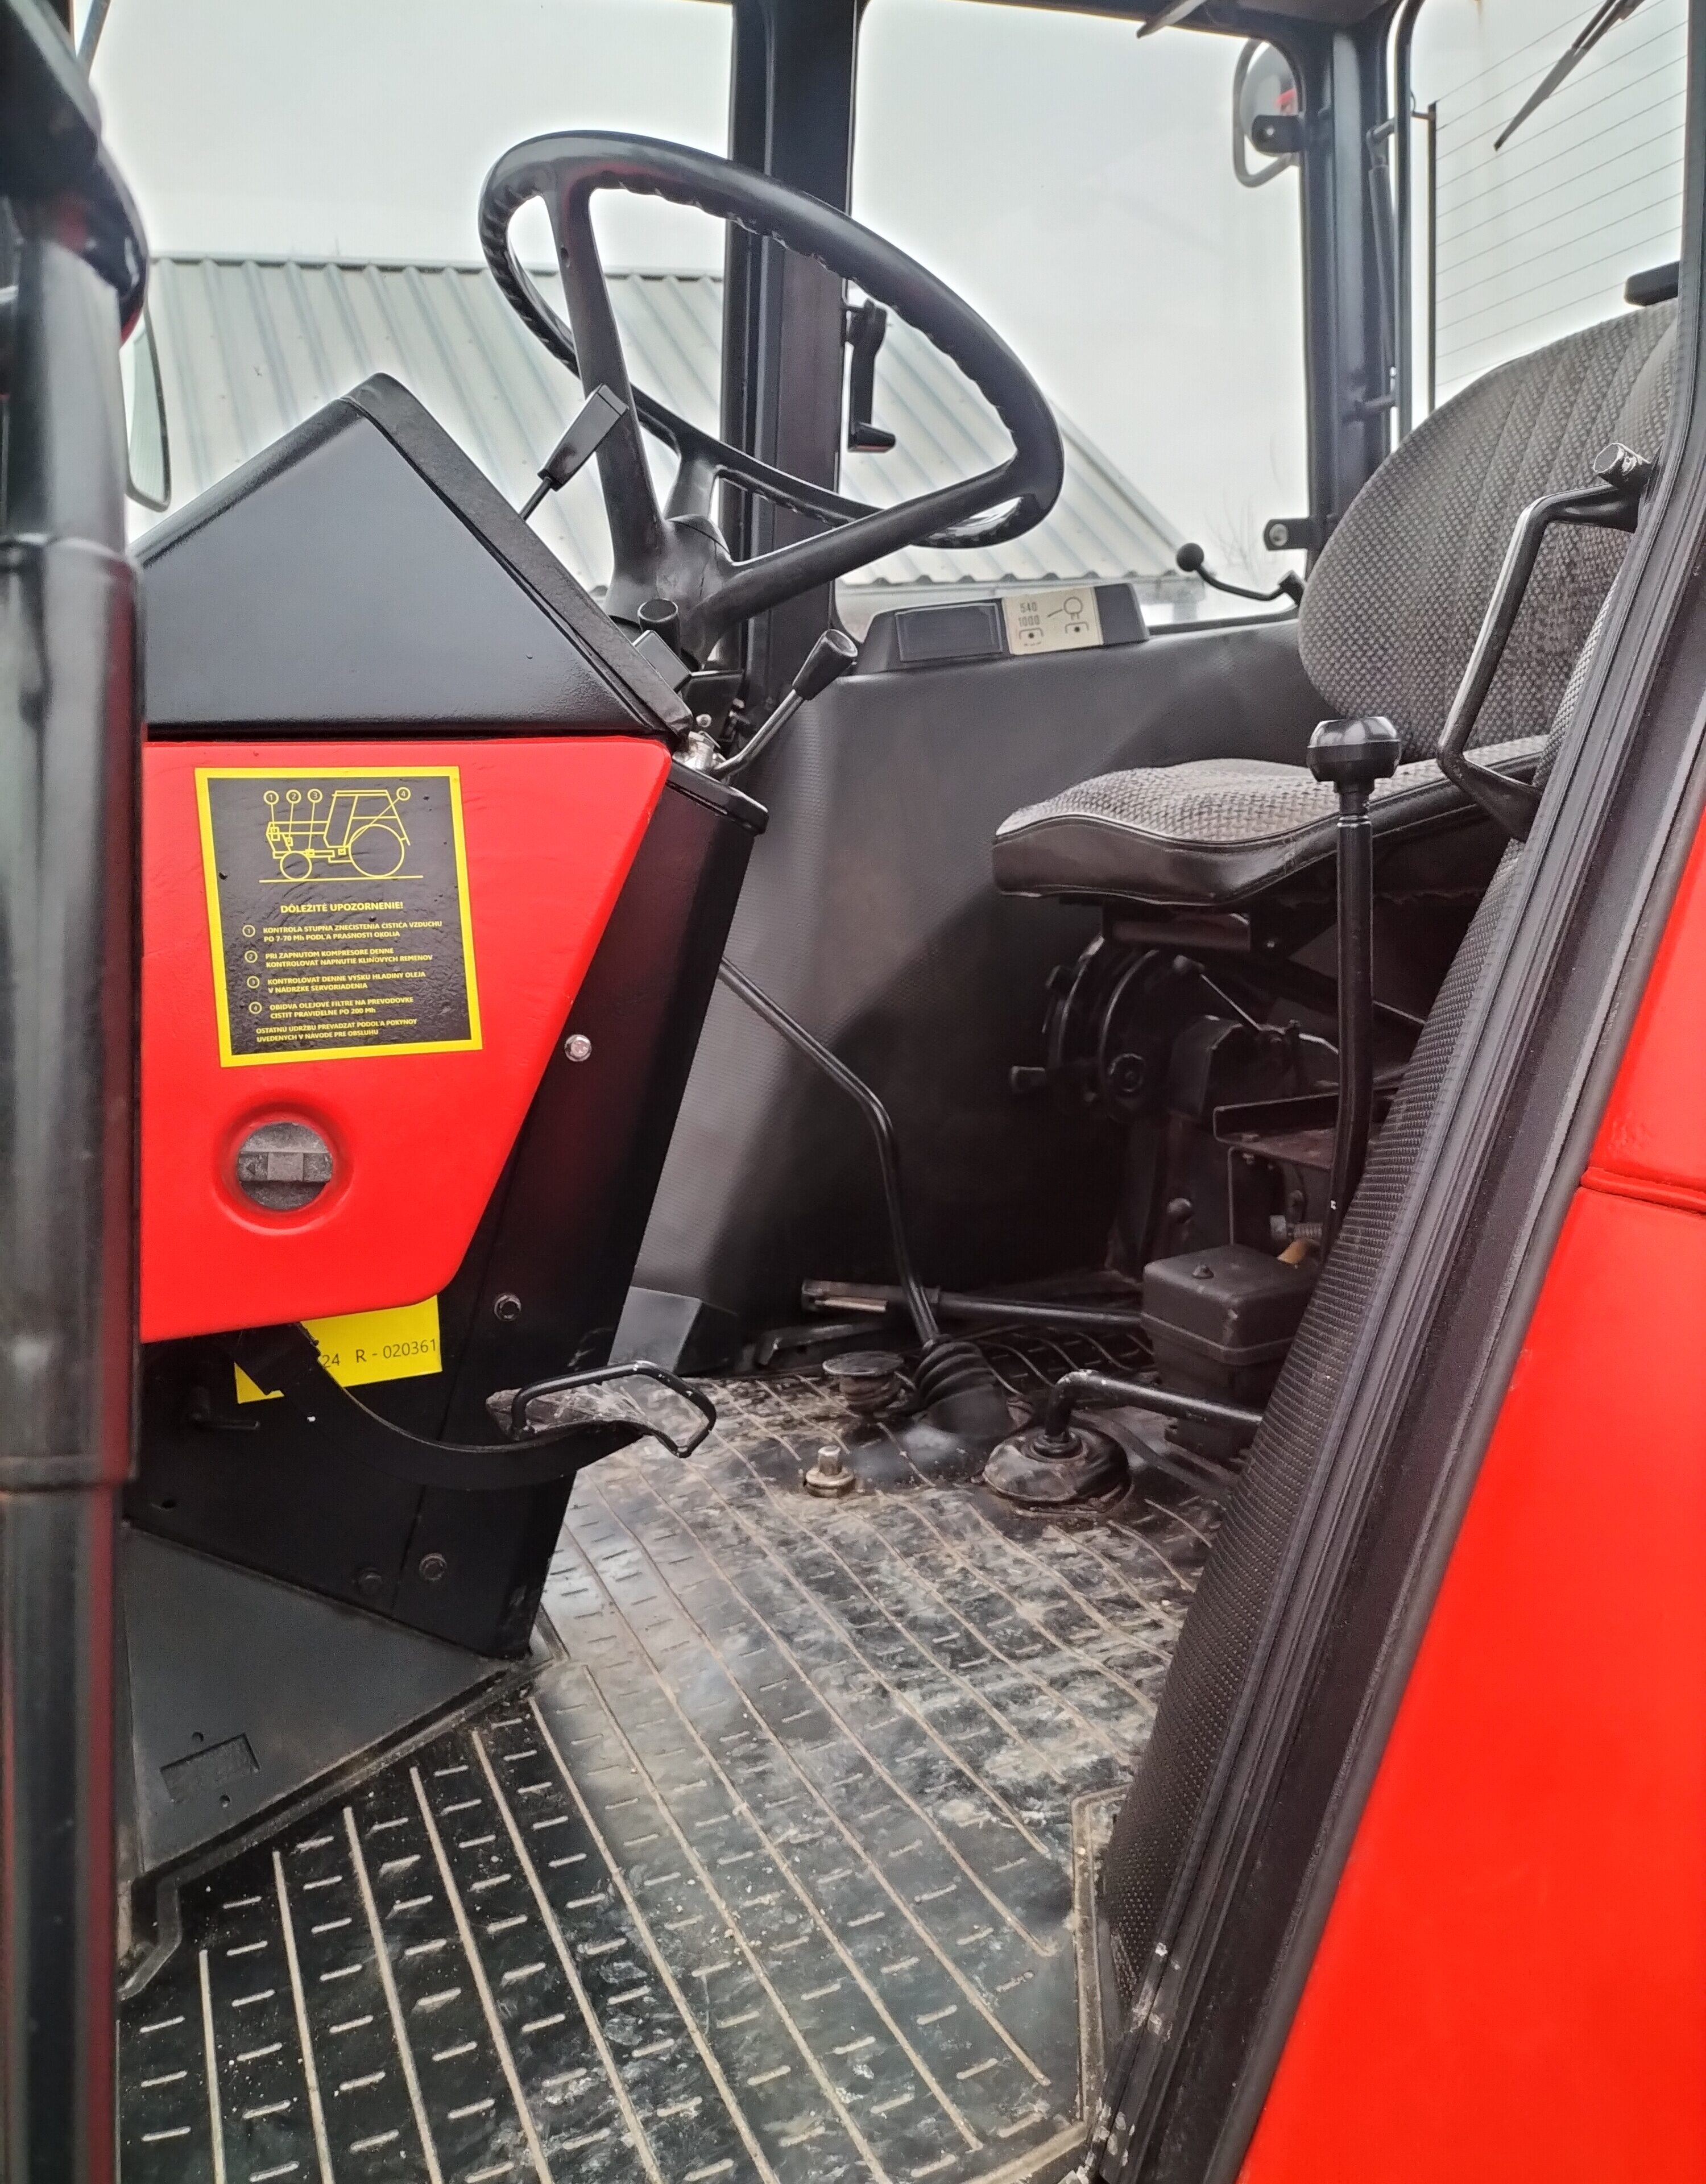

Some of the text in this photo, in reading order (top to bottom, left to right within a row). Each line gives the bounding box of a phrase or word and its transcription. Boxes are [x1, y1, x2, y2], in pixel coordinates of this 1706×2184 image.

[1018, 615, 1041, 626] 1000
[330, 901, 404, 912] UPOZORNENIE!
[311, 983, 368, 992] SERVORIADENIA
[367, 996, 413, 1005] PREVODOVKE
[294, 1010, 337, 1018] PRAVIDELNE
[355, 1349, 367, 1363] R
[383, 1338, 436, 1359] 020361
